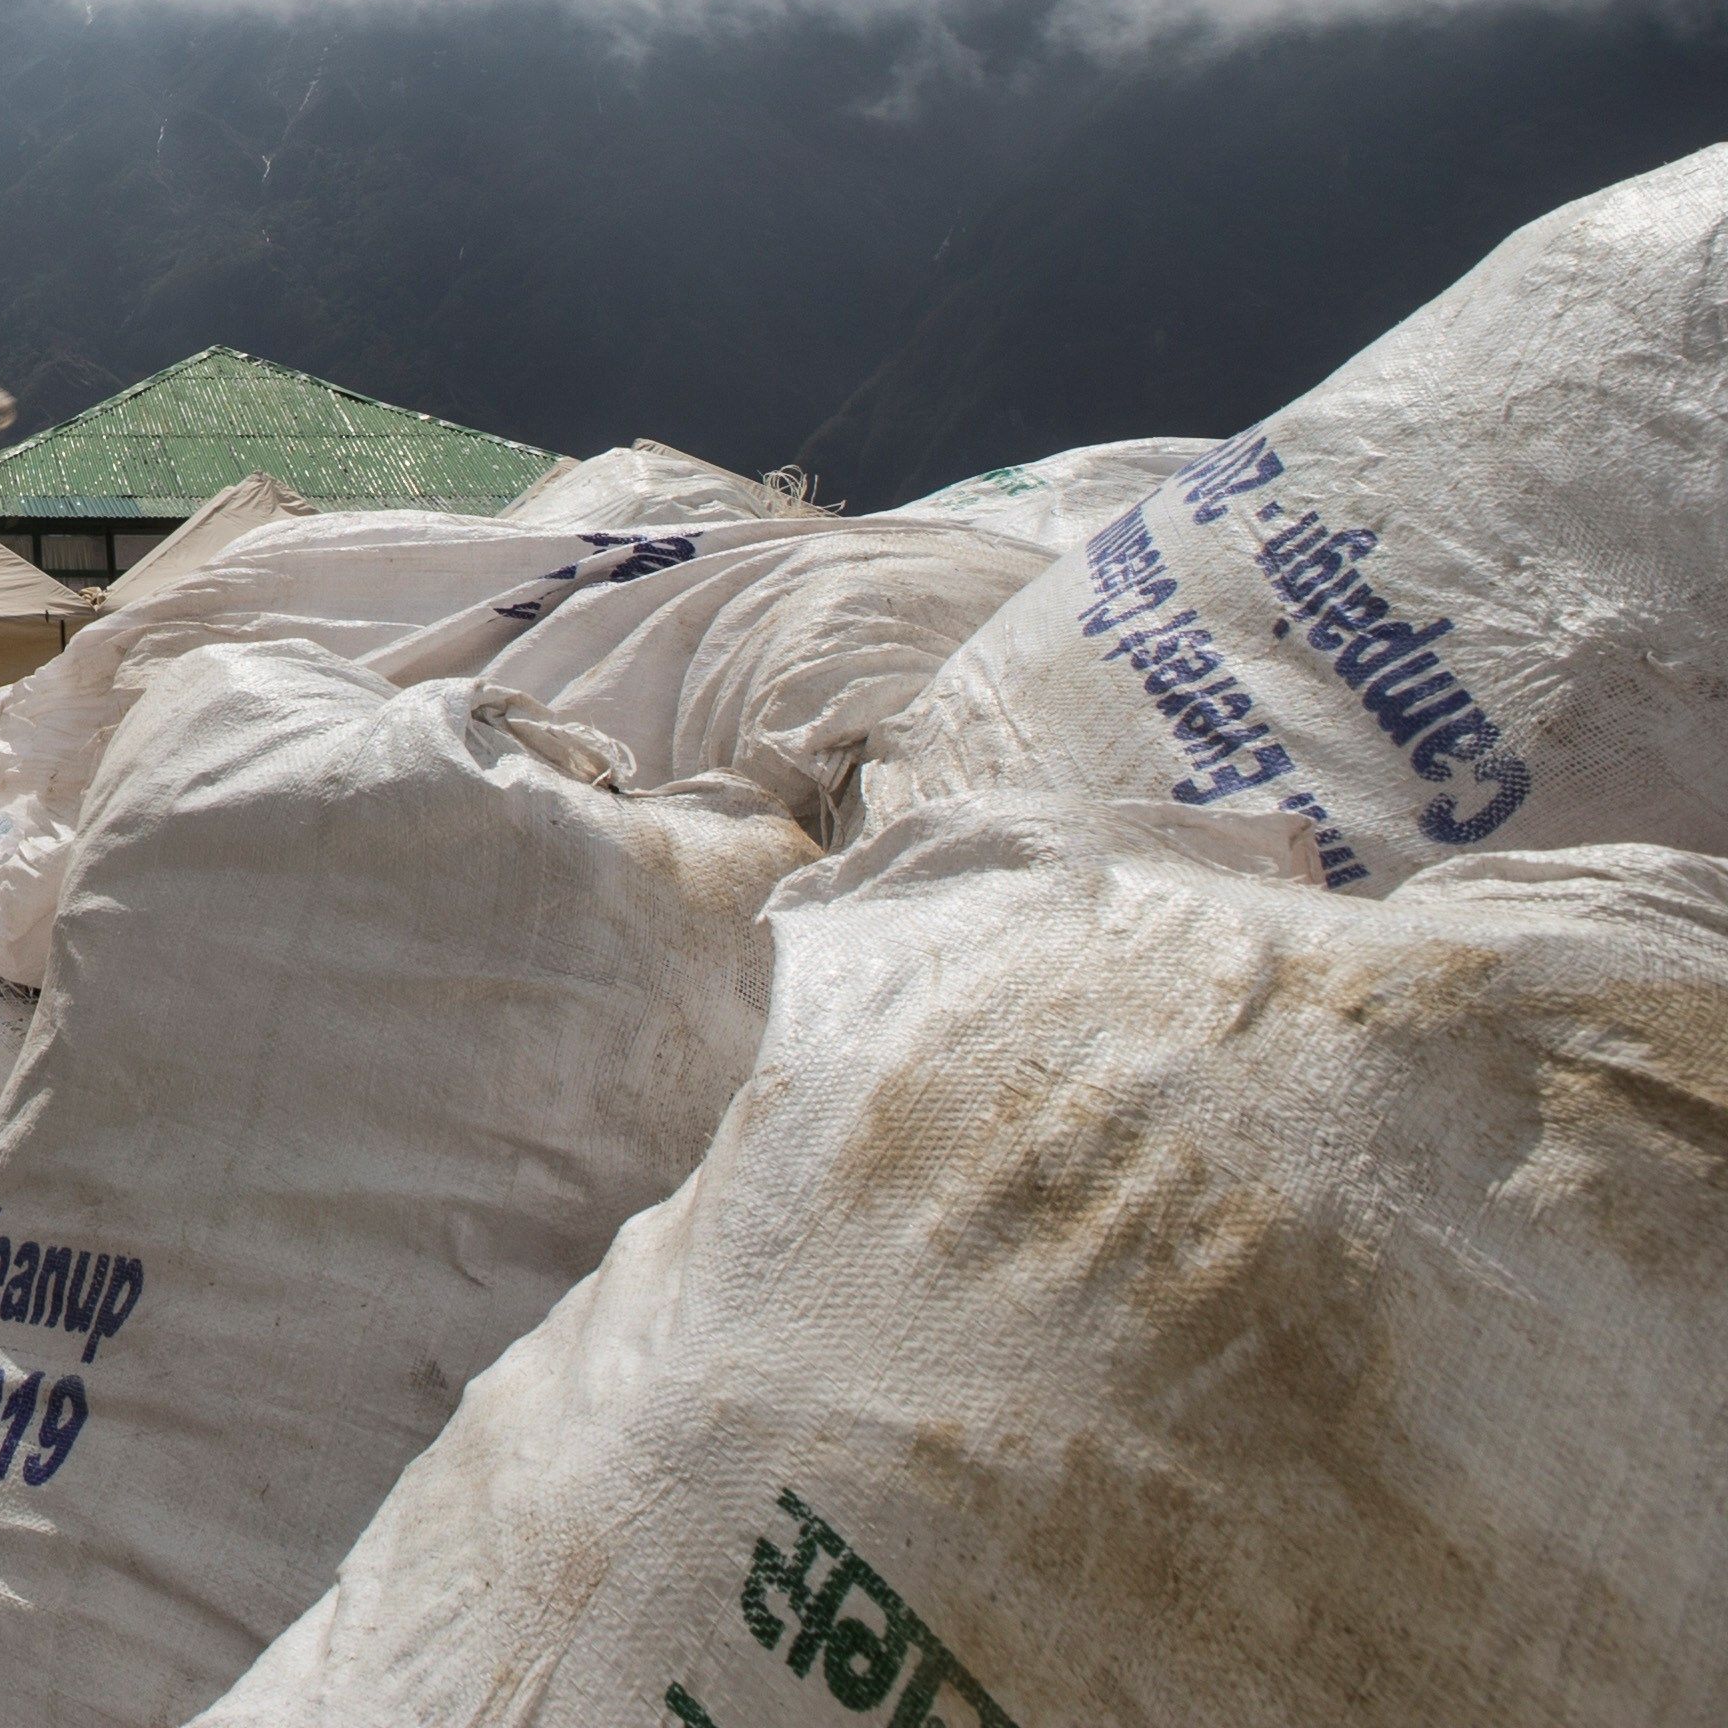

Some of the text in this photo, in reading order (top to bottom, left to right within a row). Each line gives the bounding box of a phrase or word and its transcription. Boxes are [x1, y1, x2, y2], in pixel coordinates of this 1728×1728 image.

[1078, 488, 1295, 806] Everest Cleanu
[1254, 511, 1531, 845] Campaign
